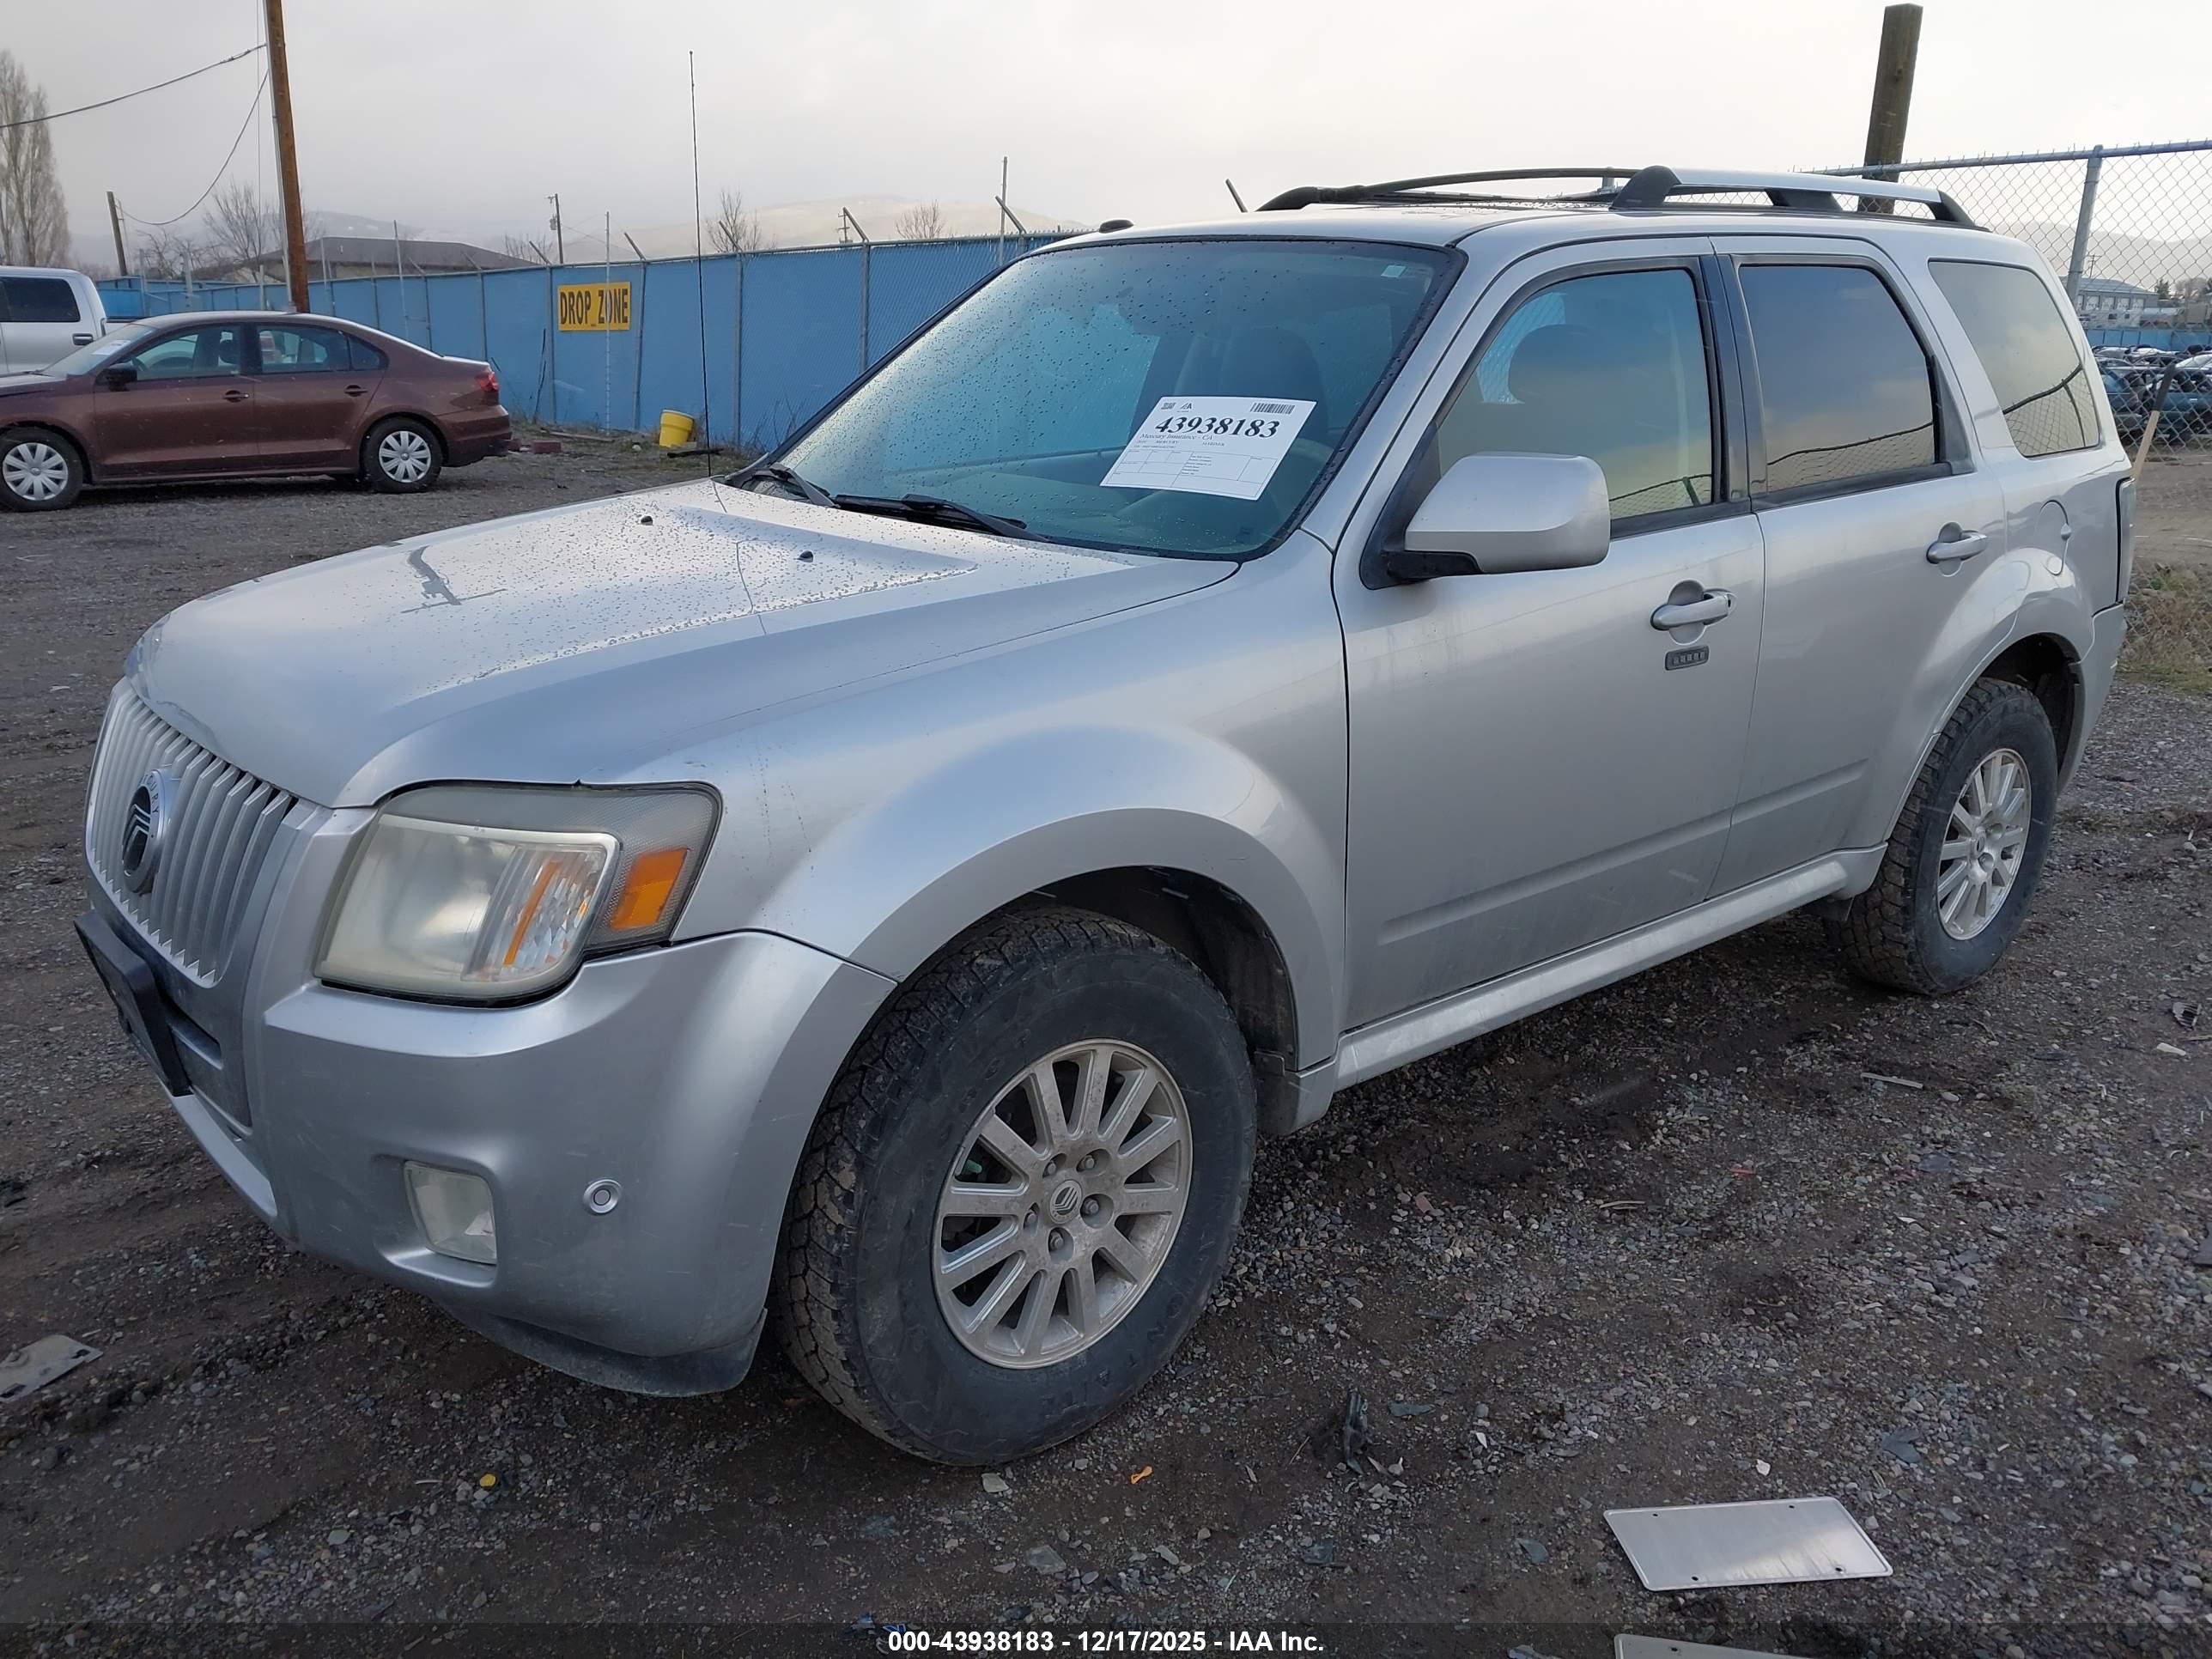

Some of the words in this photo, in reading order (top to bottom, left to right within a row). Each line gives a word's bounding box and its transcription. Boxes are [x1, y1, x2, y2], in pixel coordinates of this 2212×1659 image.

[560, 290, 591, 325] DROP
[598, 288, 629, 324] ZONE
[1155, 416, 1280, 438] 43938183
